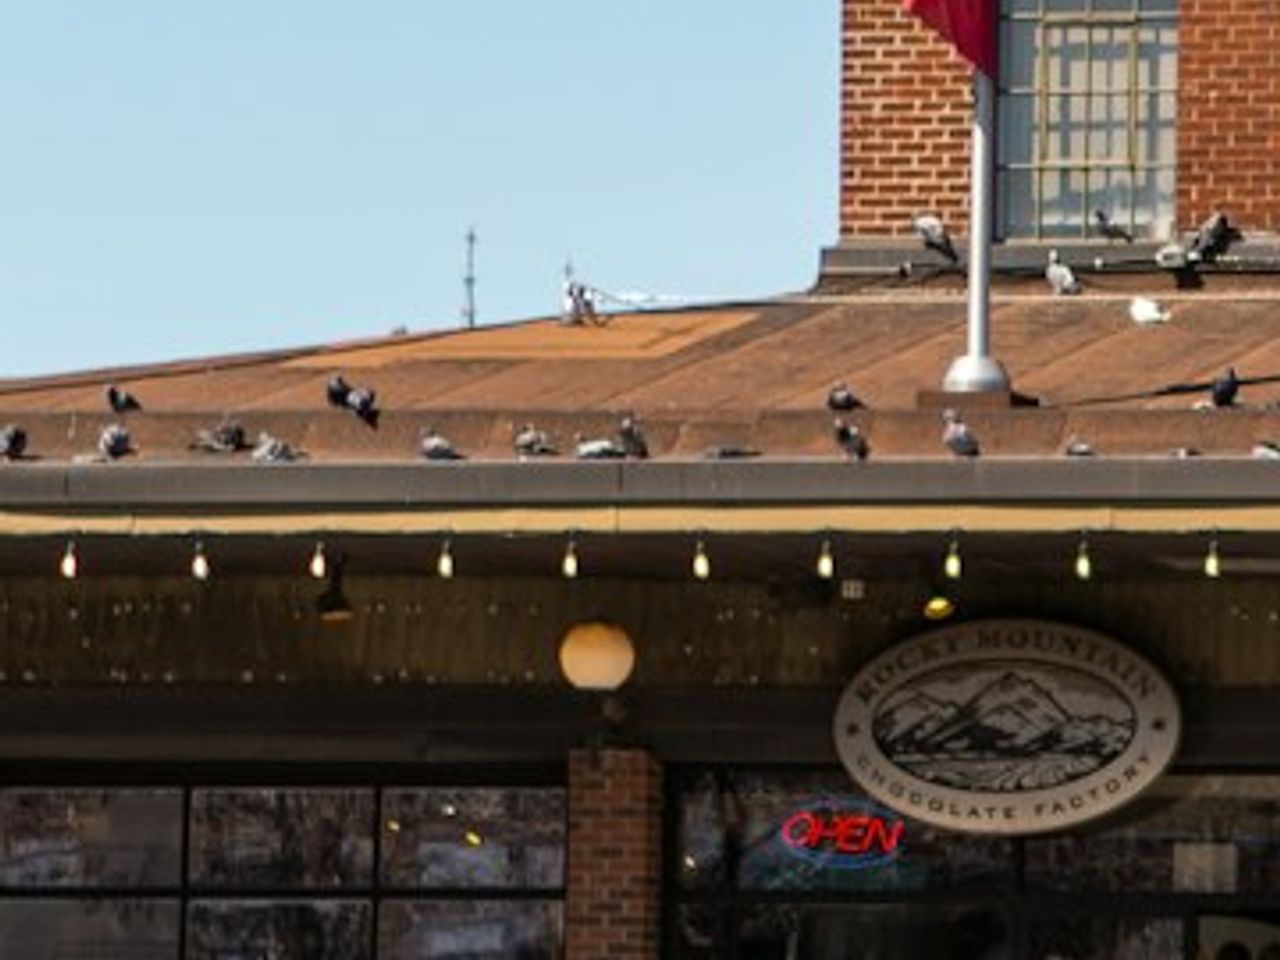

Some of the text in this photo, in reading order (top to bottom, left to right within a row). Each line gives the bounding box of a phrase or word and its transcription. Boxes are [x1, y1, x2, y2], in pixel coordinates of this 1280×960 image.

[855, 627, 1158, 706] ROCKY MOUNTAIN
[856, 754, 1151, 821] CHOCOLATE FACTORY
[781, 809, 906, 853] OPEN
